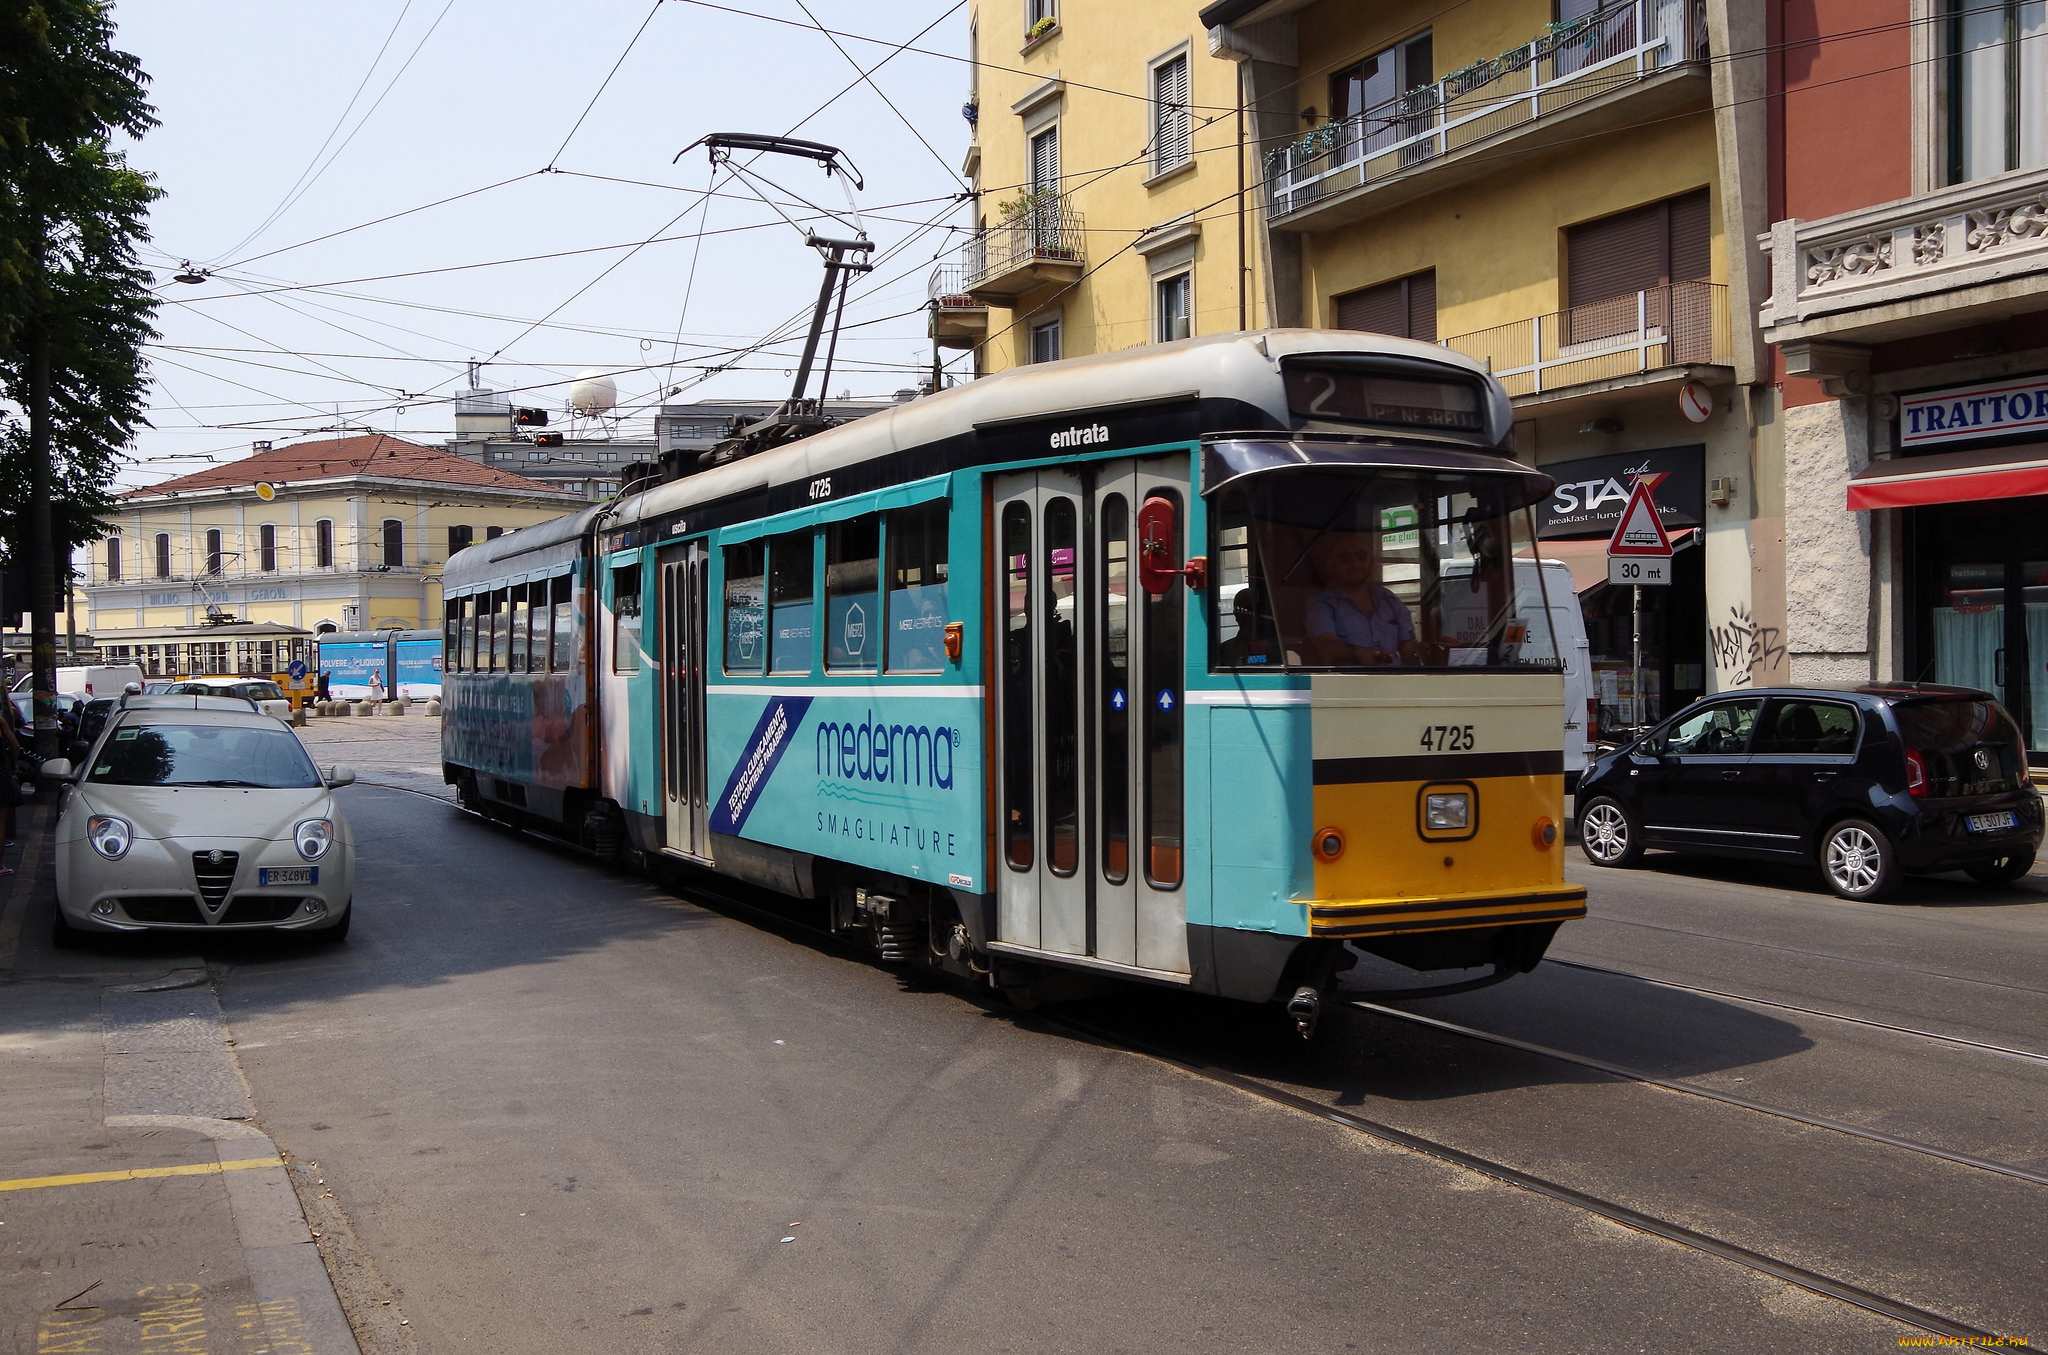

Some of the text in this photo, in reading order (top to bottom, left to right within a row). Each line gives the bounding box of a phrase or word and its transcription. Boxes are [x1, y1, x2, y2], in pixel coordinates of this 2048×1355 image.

[1304, 373, 1340, 416] 2
[1907, 390, 2048, 433] TRATTOR
[1050, 423, 1109, 448] entrata
[809, 477, 831, 499] 4725
[672, 520, 686, 534] uscita
[1548, 515, 1588, 525] breakfast
[1622, 564, 1661, 578] 30 mt
[150, 594, 179, 605] MILANO
[252, 588, 286, 600] GENOVA
[847, 623, 863, 638] MERZ
[320, 659, 348, 668] POLVERE
[359, 658, 385, 667] LIQUIDO
[1420, 725, 1474, 751] 4725
[728, 704, 785, 811] TESTATO CLINICAMENTE
[731, 717, 788, 824] NON CONTIENE PARABENI
[817, 811, 955, 856] SMAGLIATURE
